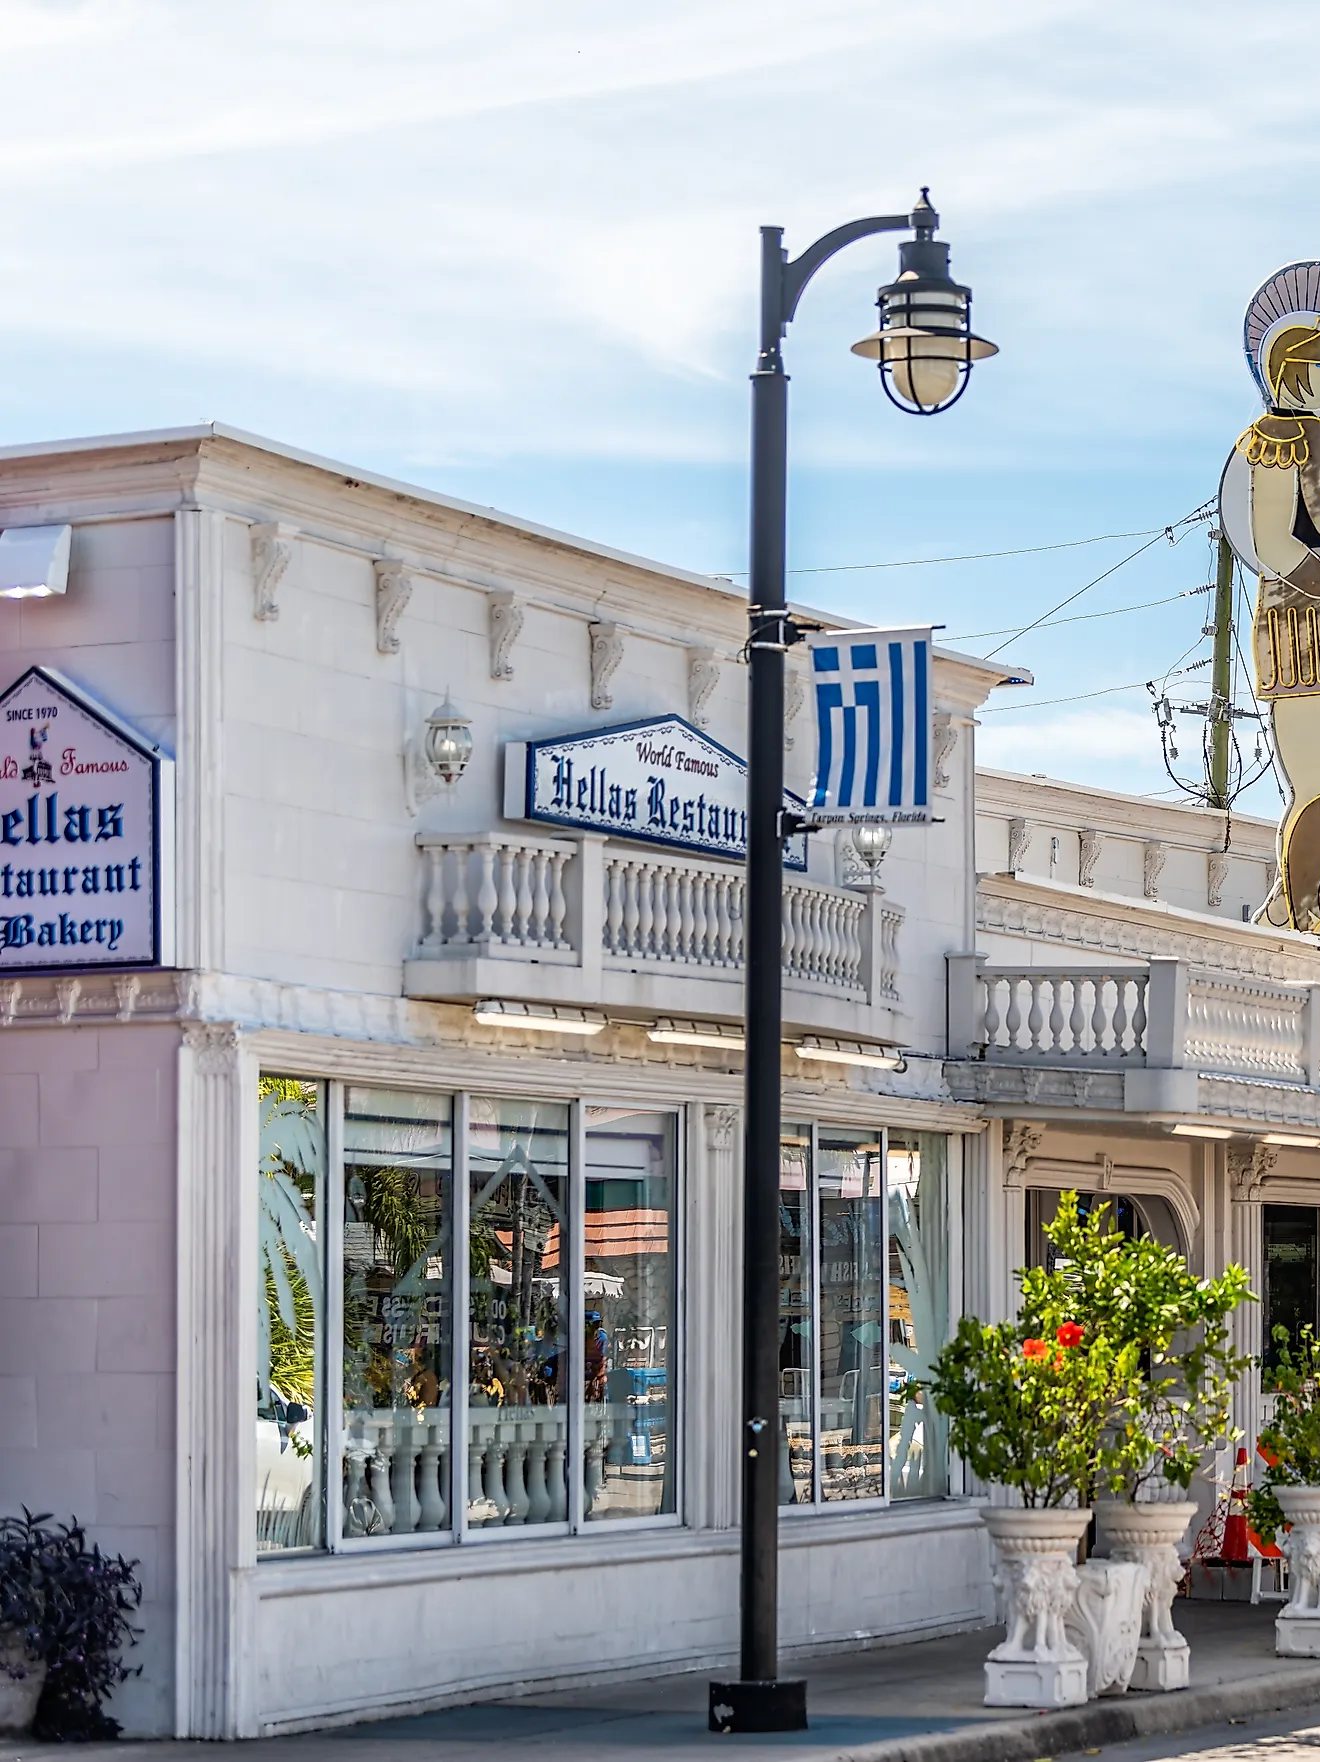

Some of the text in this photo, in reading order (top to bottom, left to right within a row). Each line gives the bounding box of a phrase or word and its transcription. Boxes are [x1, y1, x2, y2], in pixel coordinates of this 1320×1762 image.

[6, 707, 58, 721] SINCE 1970
[60, 748, 129, 776] Famous
[636, 741, 719, 778] World Famous
[551, 755, 747, 844] Hellas Restaur
[811, 812, 845, 824] Tarpon
[892, 810, 926, 824] Florida
[0, 912, 124, 951] Bakery
